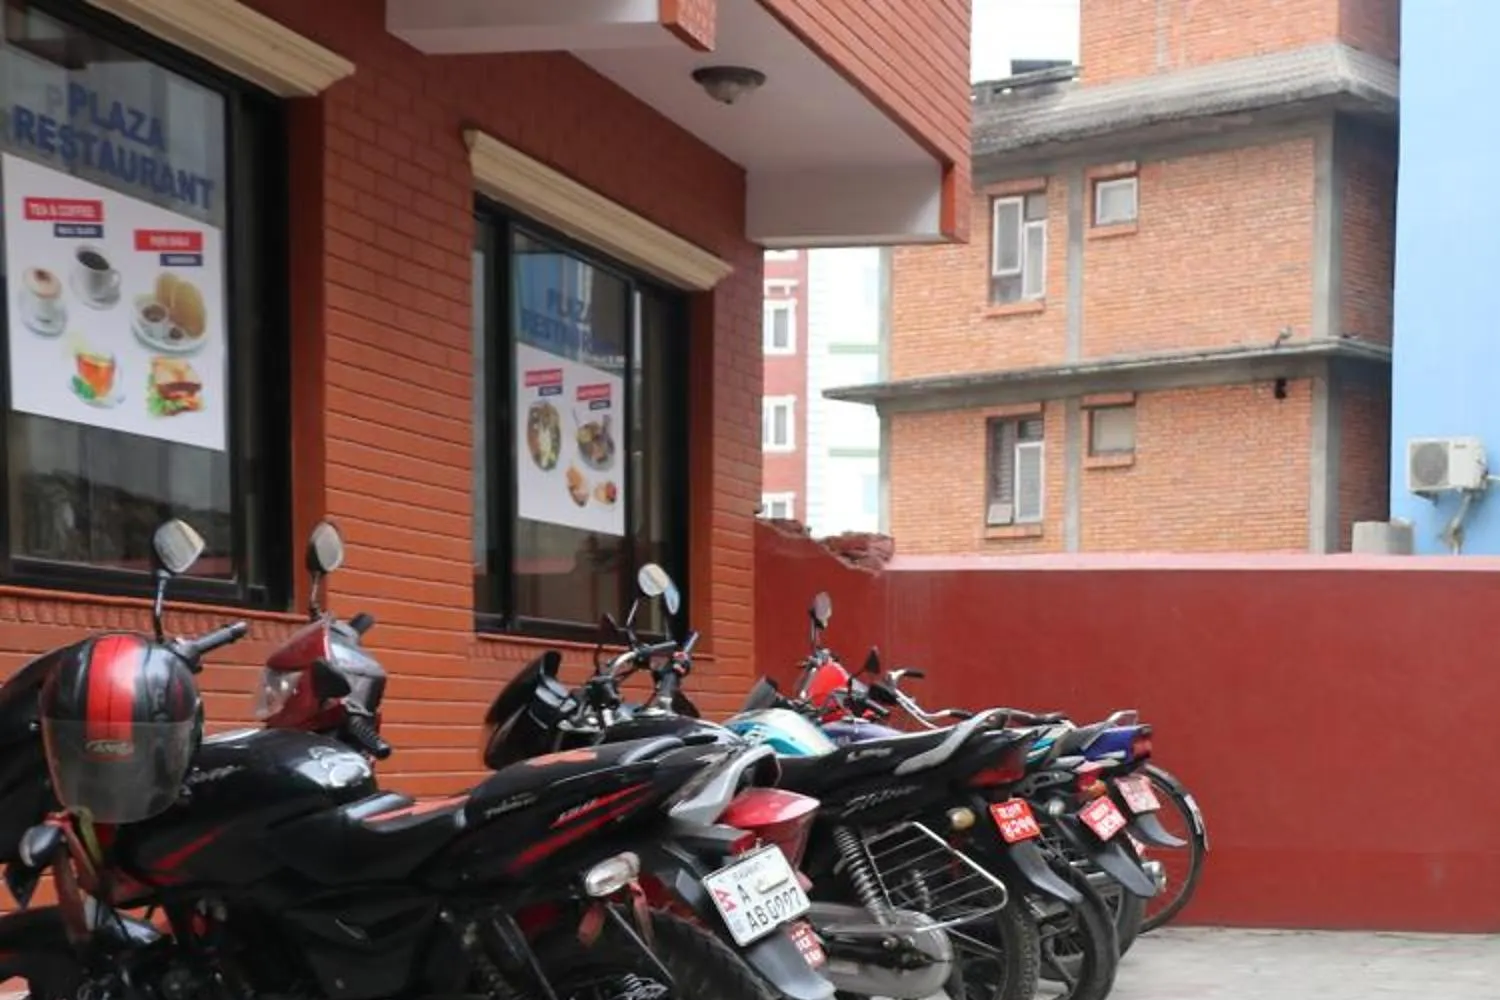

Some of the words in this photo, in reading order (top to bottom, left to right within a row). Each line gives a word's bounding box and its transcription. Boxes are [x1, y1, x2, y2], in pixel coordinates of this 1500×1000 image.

[66, 81, 168, 153] PLAZA
[12, 104, 215, 209] RESTAURANT
[736, 884, 752, 904] A
